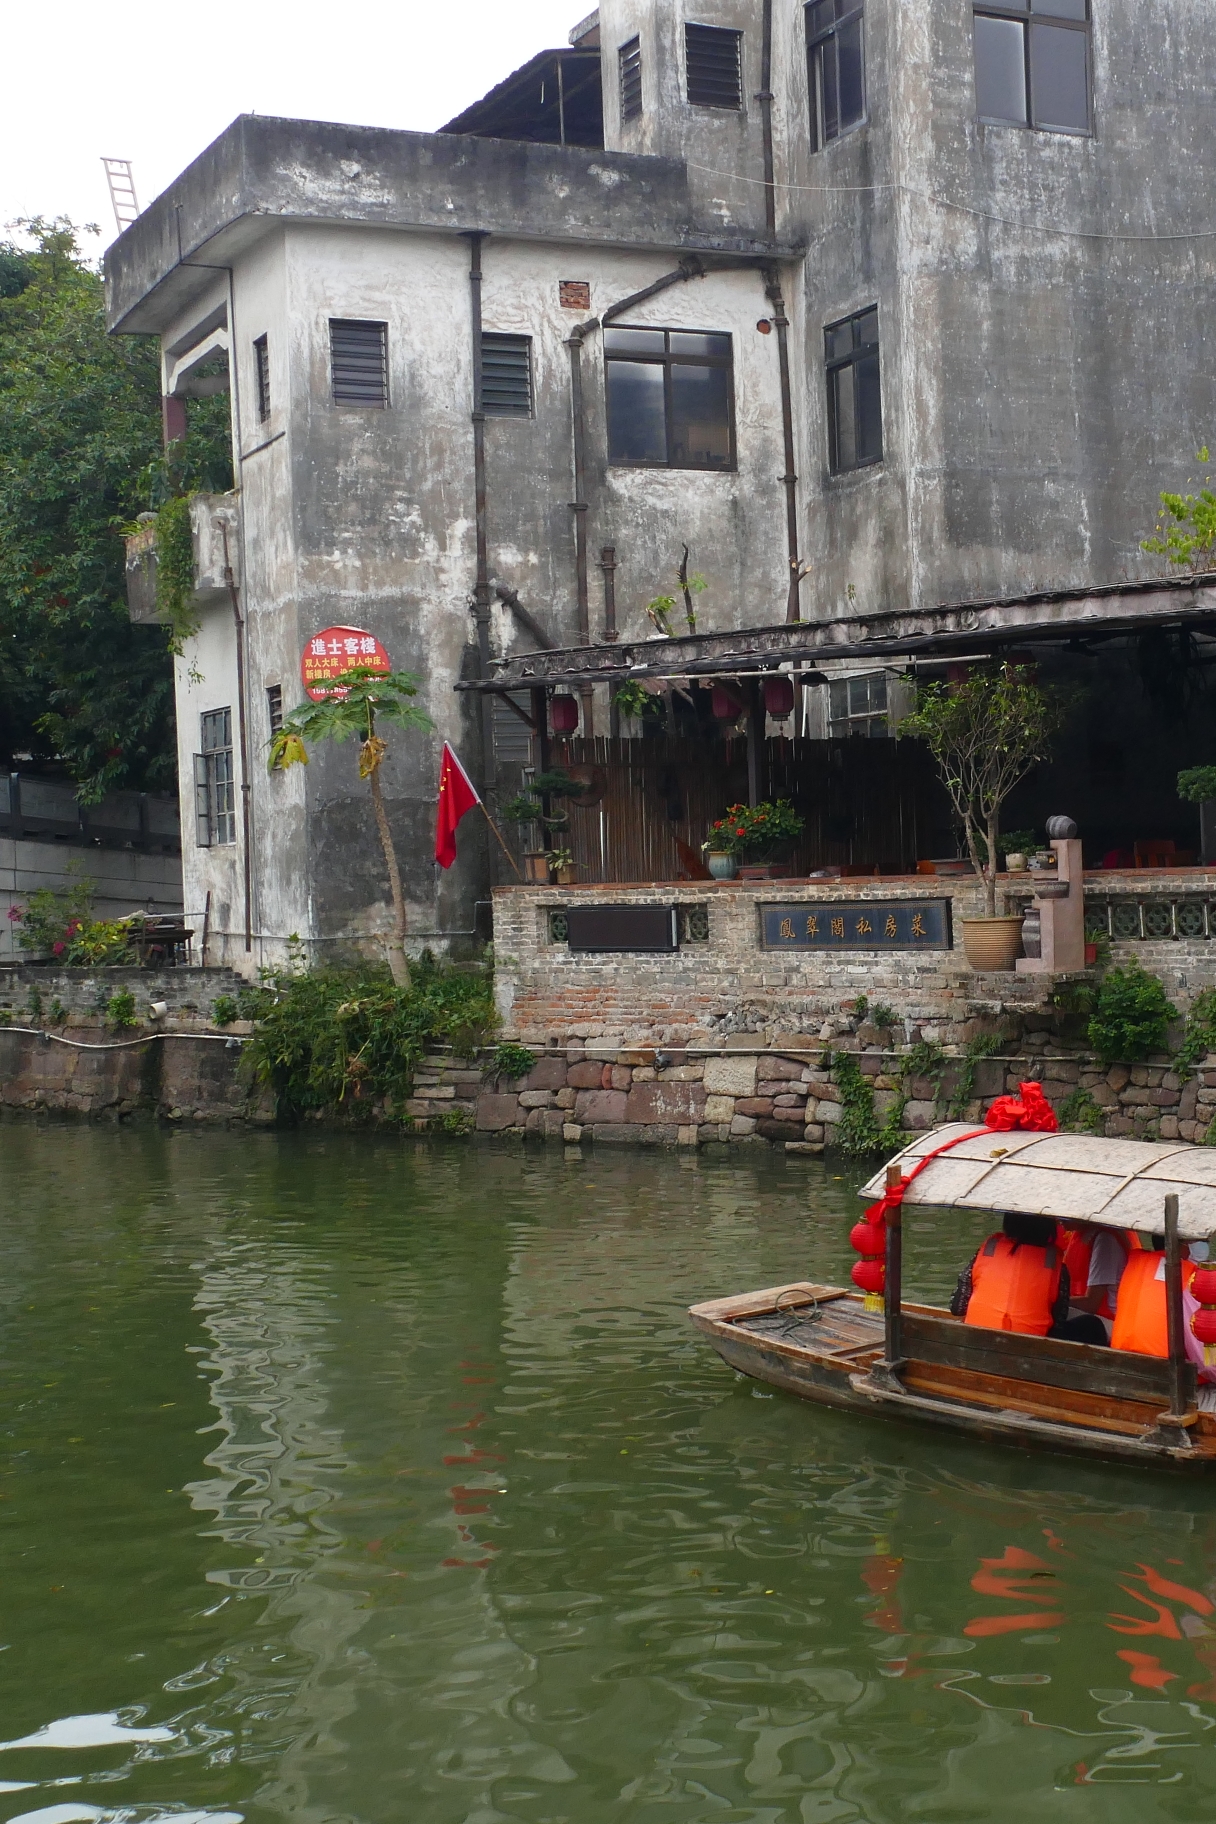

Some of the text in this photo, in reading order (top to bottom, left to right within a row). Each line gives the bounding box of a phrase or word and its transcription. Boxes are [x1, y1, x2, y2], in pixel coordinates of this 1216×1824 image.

[311, 638, 376, 656] 進士客棧
[779, 913, 927, 938] 鳳翠閣私房菜
